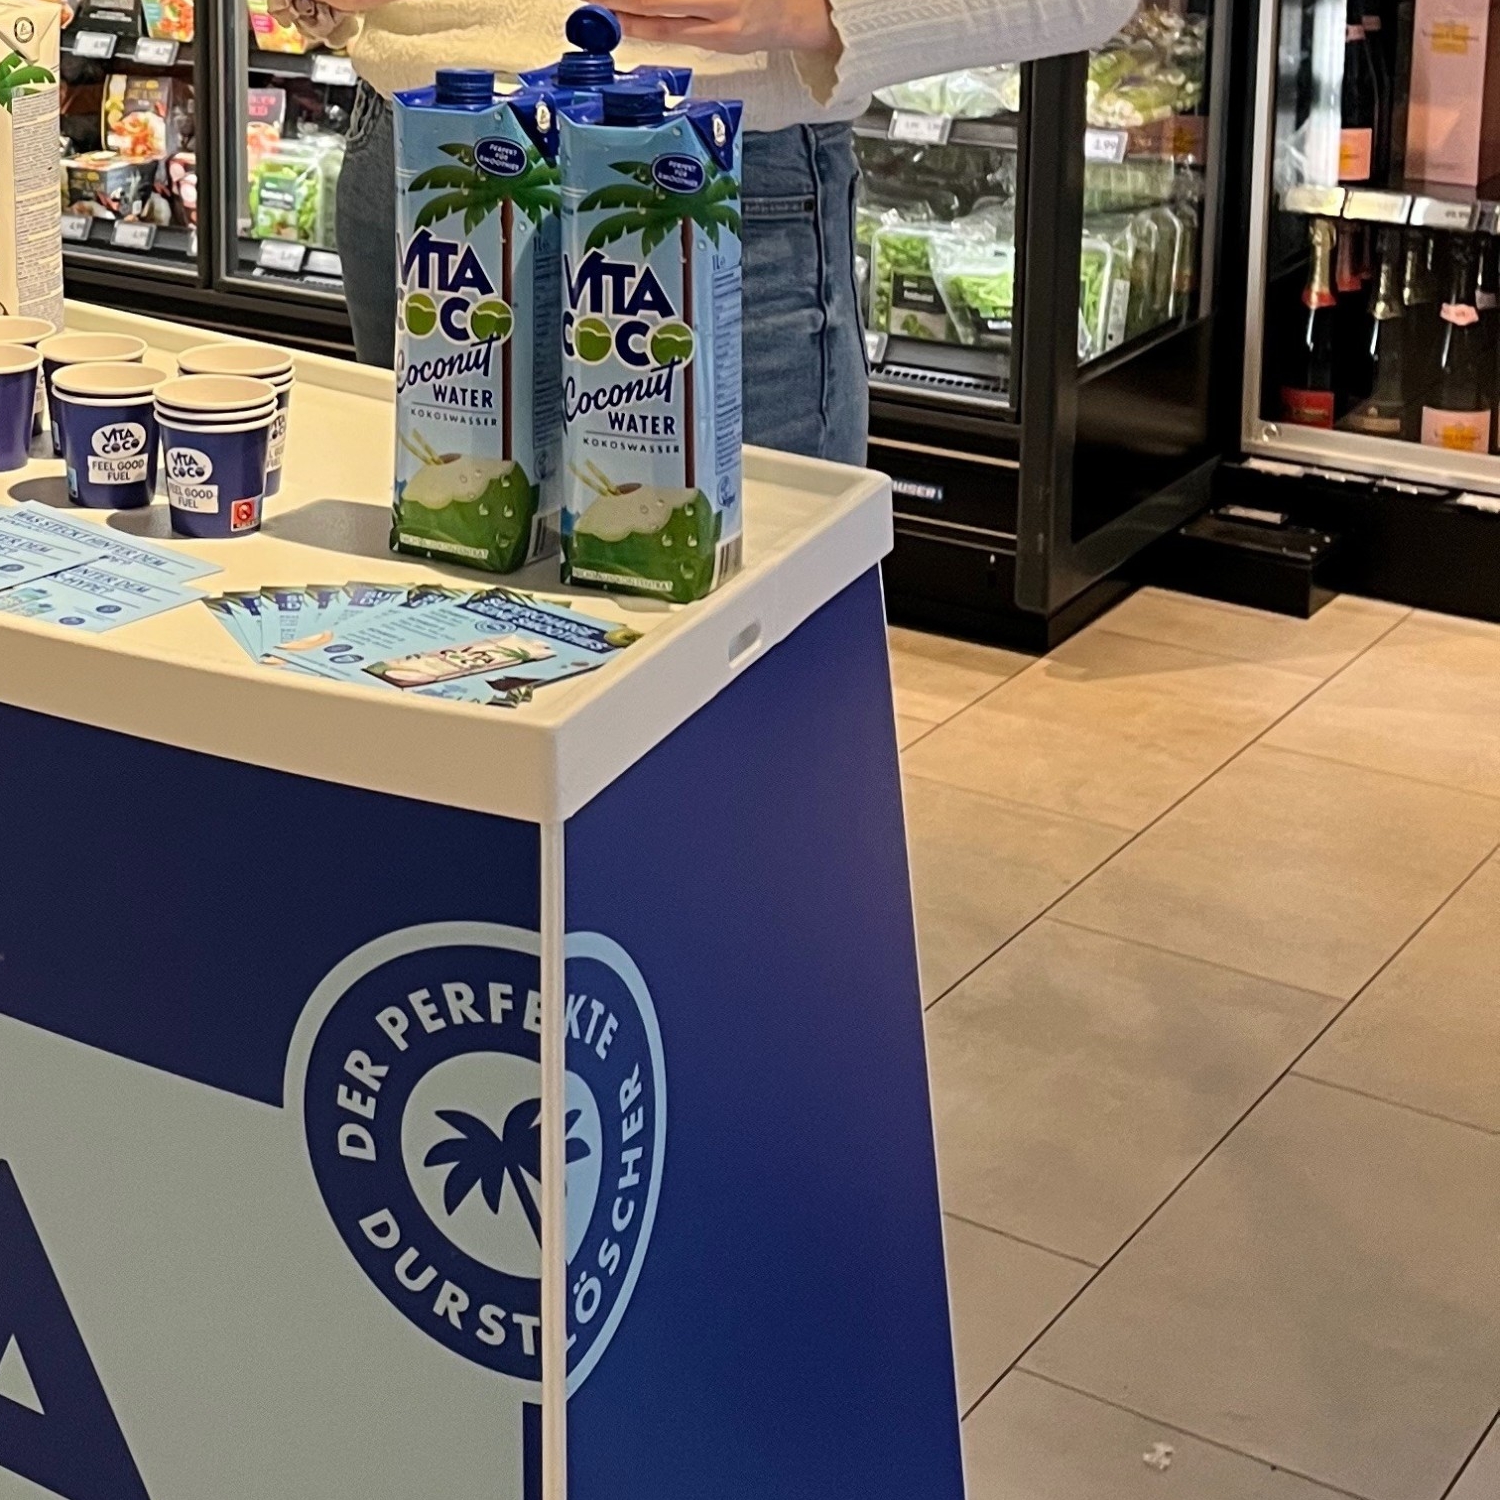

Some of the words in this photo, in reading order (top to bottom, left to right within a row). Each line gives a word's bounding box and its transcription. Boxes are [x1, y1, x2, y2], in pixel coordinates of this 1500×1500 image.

[397, 227, 494, 296] VITA
[564, 249, 677, 320] VITA
[563, 311, 694, 368] COCO
[397, 331, 501, 393] Coconut
[432, 383, 494, 409] WATER
[563, 356, 682, 430] Coconut
[410, 408, 498, 427] KOKOSWASSER
[608, 411, 676, 436] WATER
[101, 427, 135, 444] VITA
[102, 438, 140, 454] COCO
[582, 437, 680, 454] KOKOSWASSER
[92, 460, 114, 471] FEEL
[117, 458, 145, 470] GOOD
[171, 452, 198, 468] VITA
[107, 470, 131, 482] FUEL
[172, 465, 205, 479] COCO
[184, 487, 213, 499] GOOD
[177, 497, 199, 510] FUEL
[336, 1048, 389, 1162] DER
[375, 981, 620, 1061] PERFEKTE
